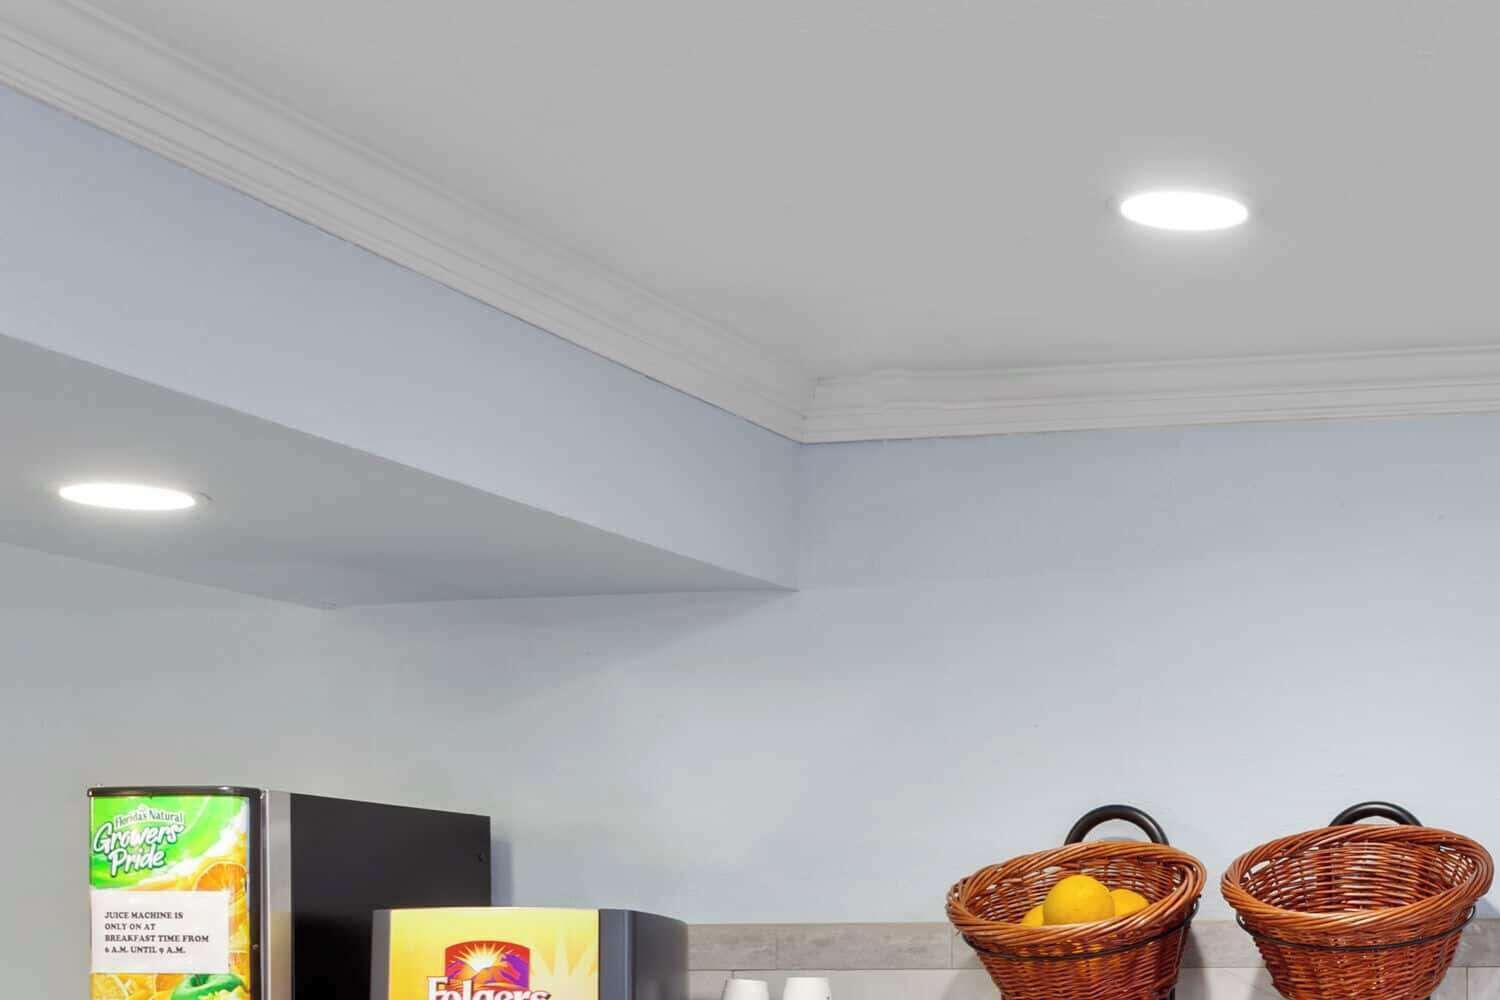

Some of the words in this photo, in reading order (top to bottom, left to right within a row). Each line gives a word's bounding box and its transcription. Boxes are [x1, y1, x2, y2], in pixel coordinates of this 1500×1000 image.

[149, 810, 183, 823] Natural
[108, 843, 166, 877] Pride
[104, 911, 129, 919] JUICE
[131, 911, 172, 919] MACHINE
[182, 935, 209, 943] FROM
